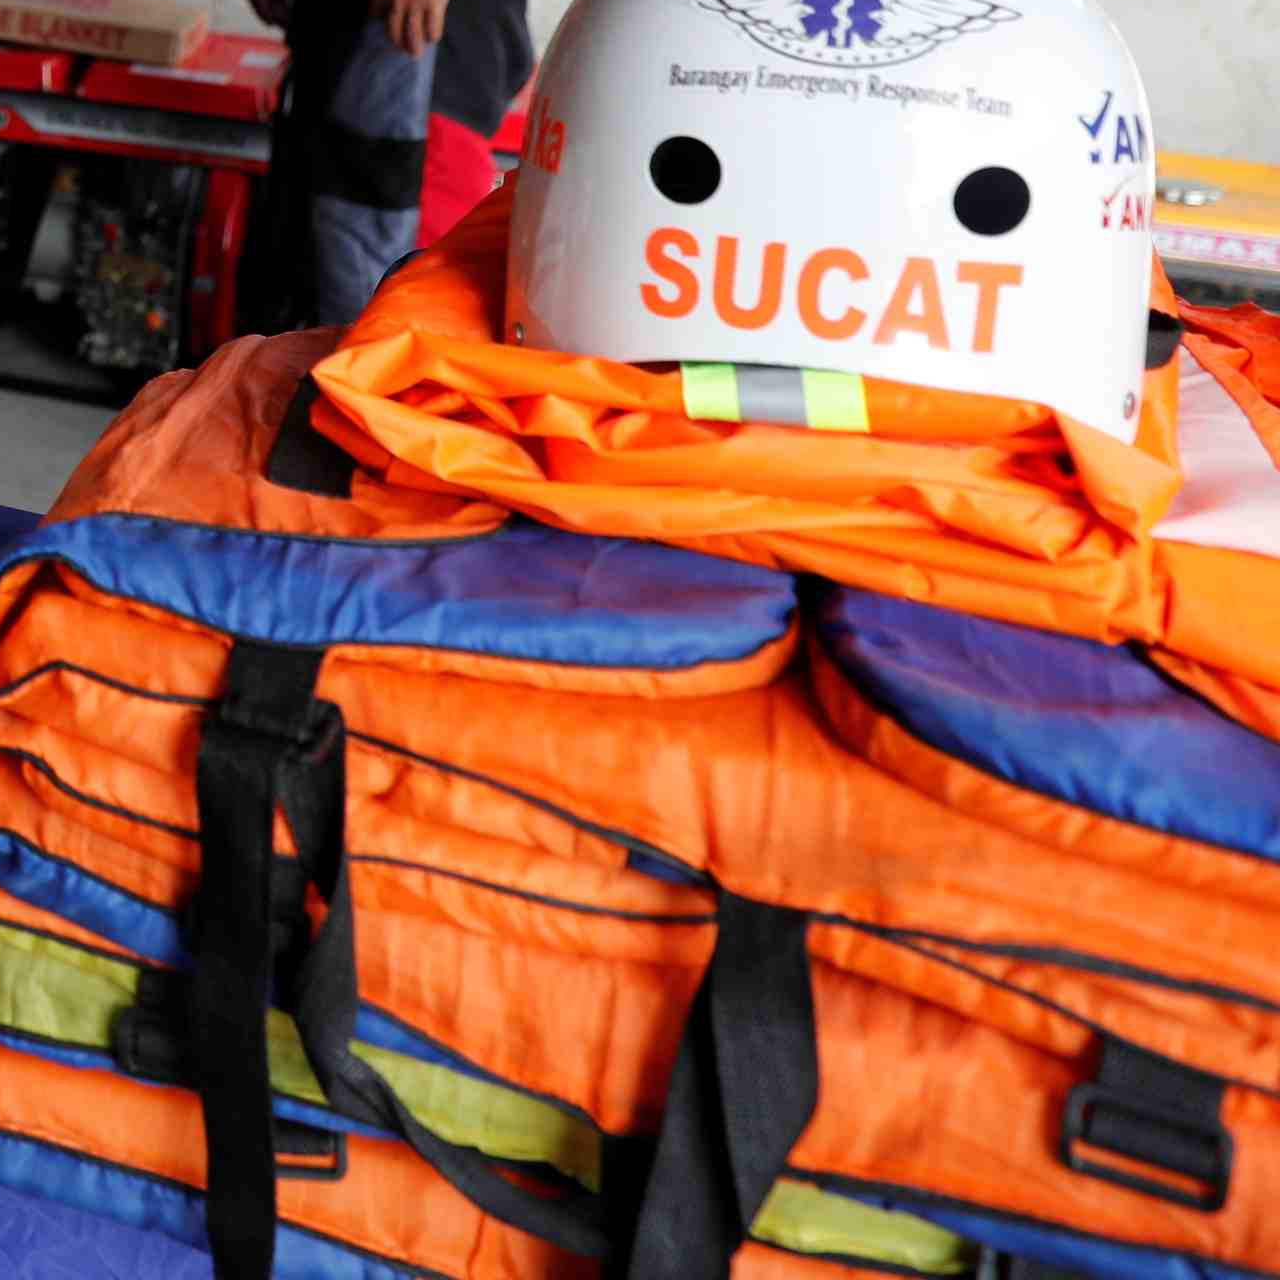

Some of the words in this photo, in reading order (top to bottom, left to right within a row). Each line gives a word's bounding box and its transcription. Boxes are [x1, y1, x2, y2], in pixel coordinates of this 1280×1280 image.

[19, 10, 131, 53] BLANKET
[668, 64, 751, 94] Barangay
[755, 65, 861, 97] Emergency
[867, 77, 960, 108] Response
[965, 88, 1014, 118] Team
[639, 226, 1024, 354] SUCAT
